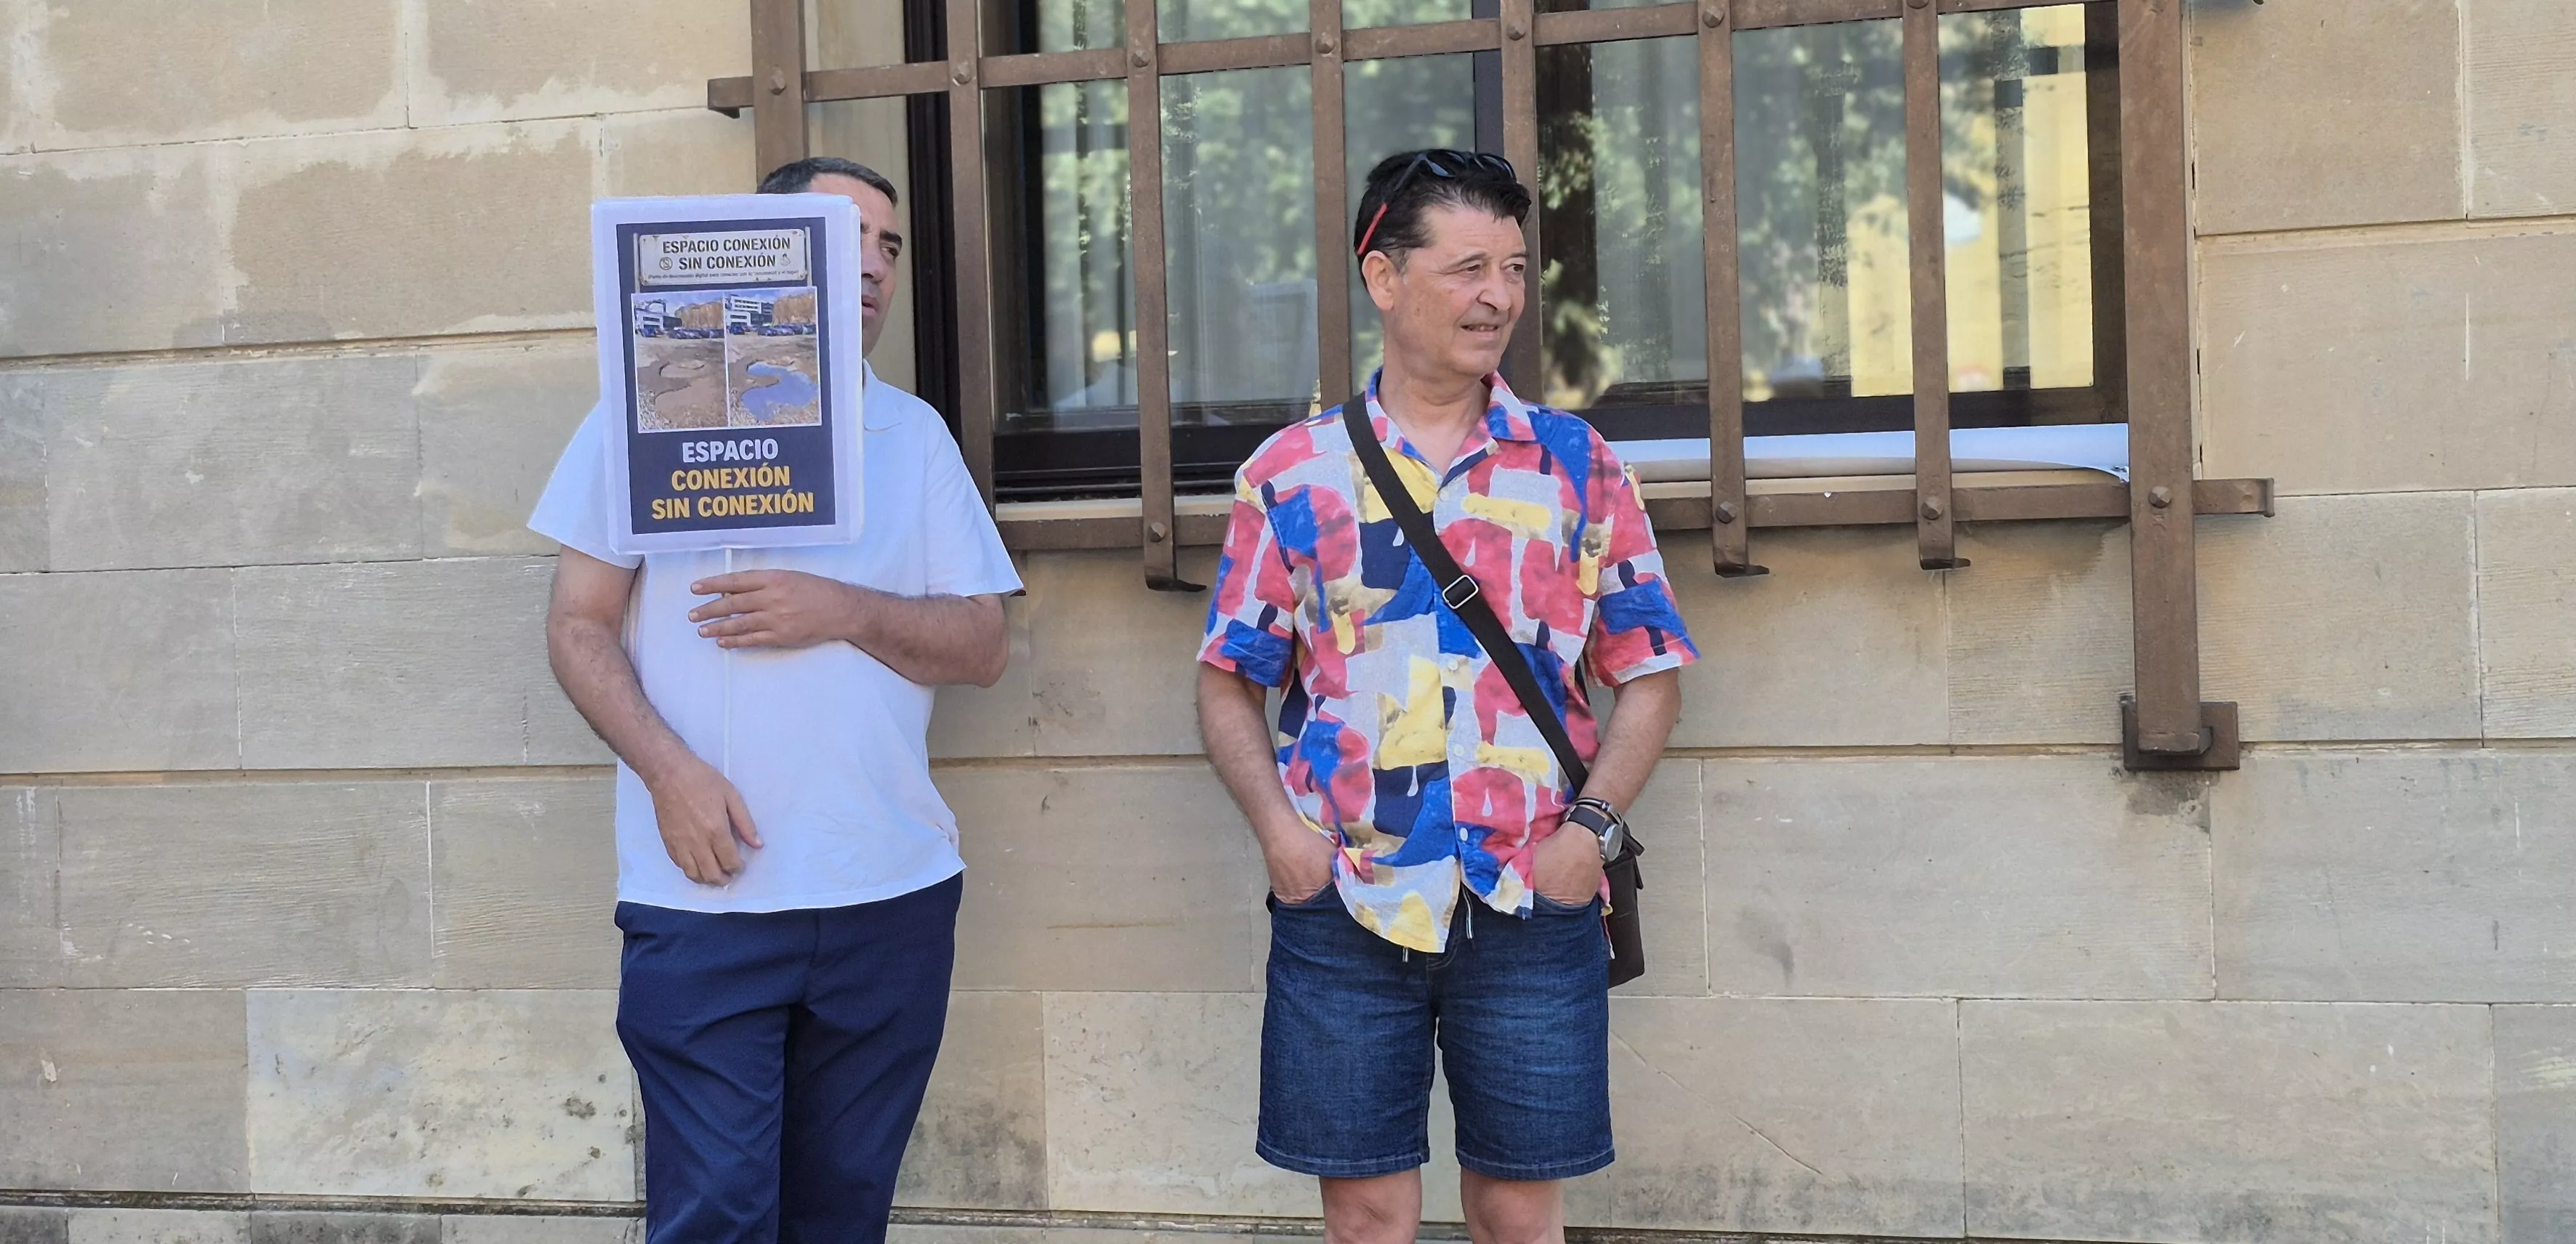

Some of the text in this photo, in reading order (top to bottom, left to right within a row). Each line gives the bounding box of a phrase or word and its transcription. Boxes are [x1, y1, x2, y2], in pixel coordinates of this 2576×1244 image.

[663, 234, 790, 254] ESPACIO CONEXIÓN
[679, 252, 775, 270] SIN CONEXIÓN
[682, 438, 779, 463] ESPACIO
[671, 462, 790, 491] CONEXIÓN
[651, 488, 814, 520] SIN CONEXIÓN
